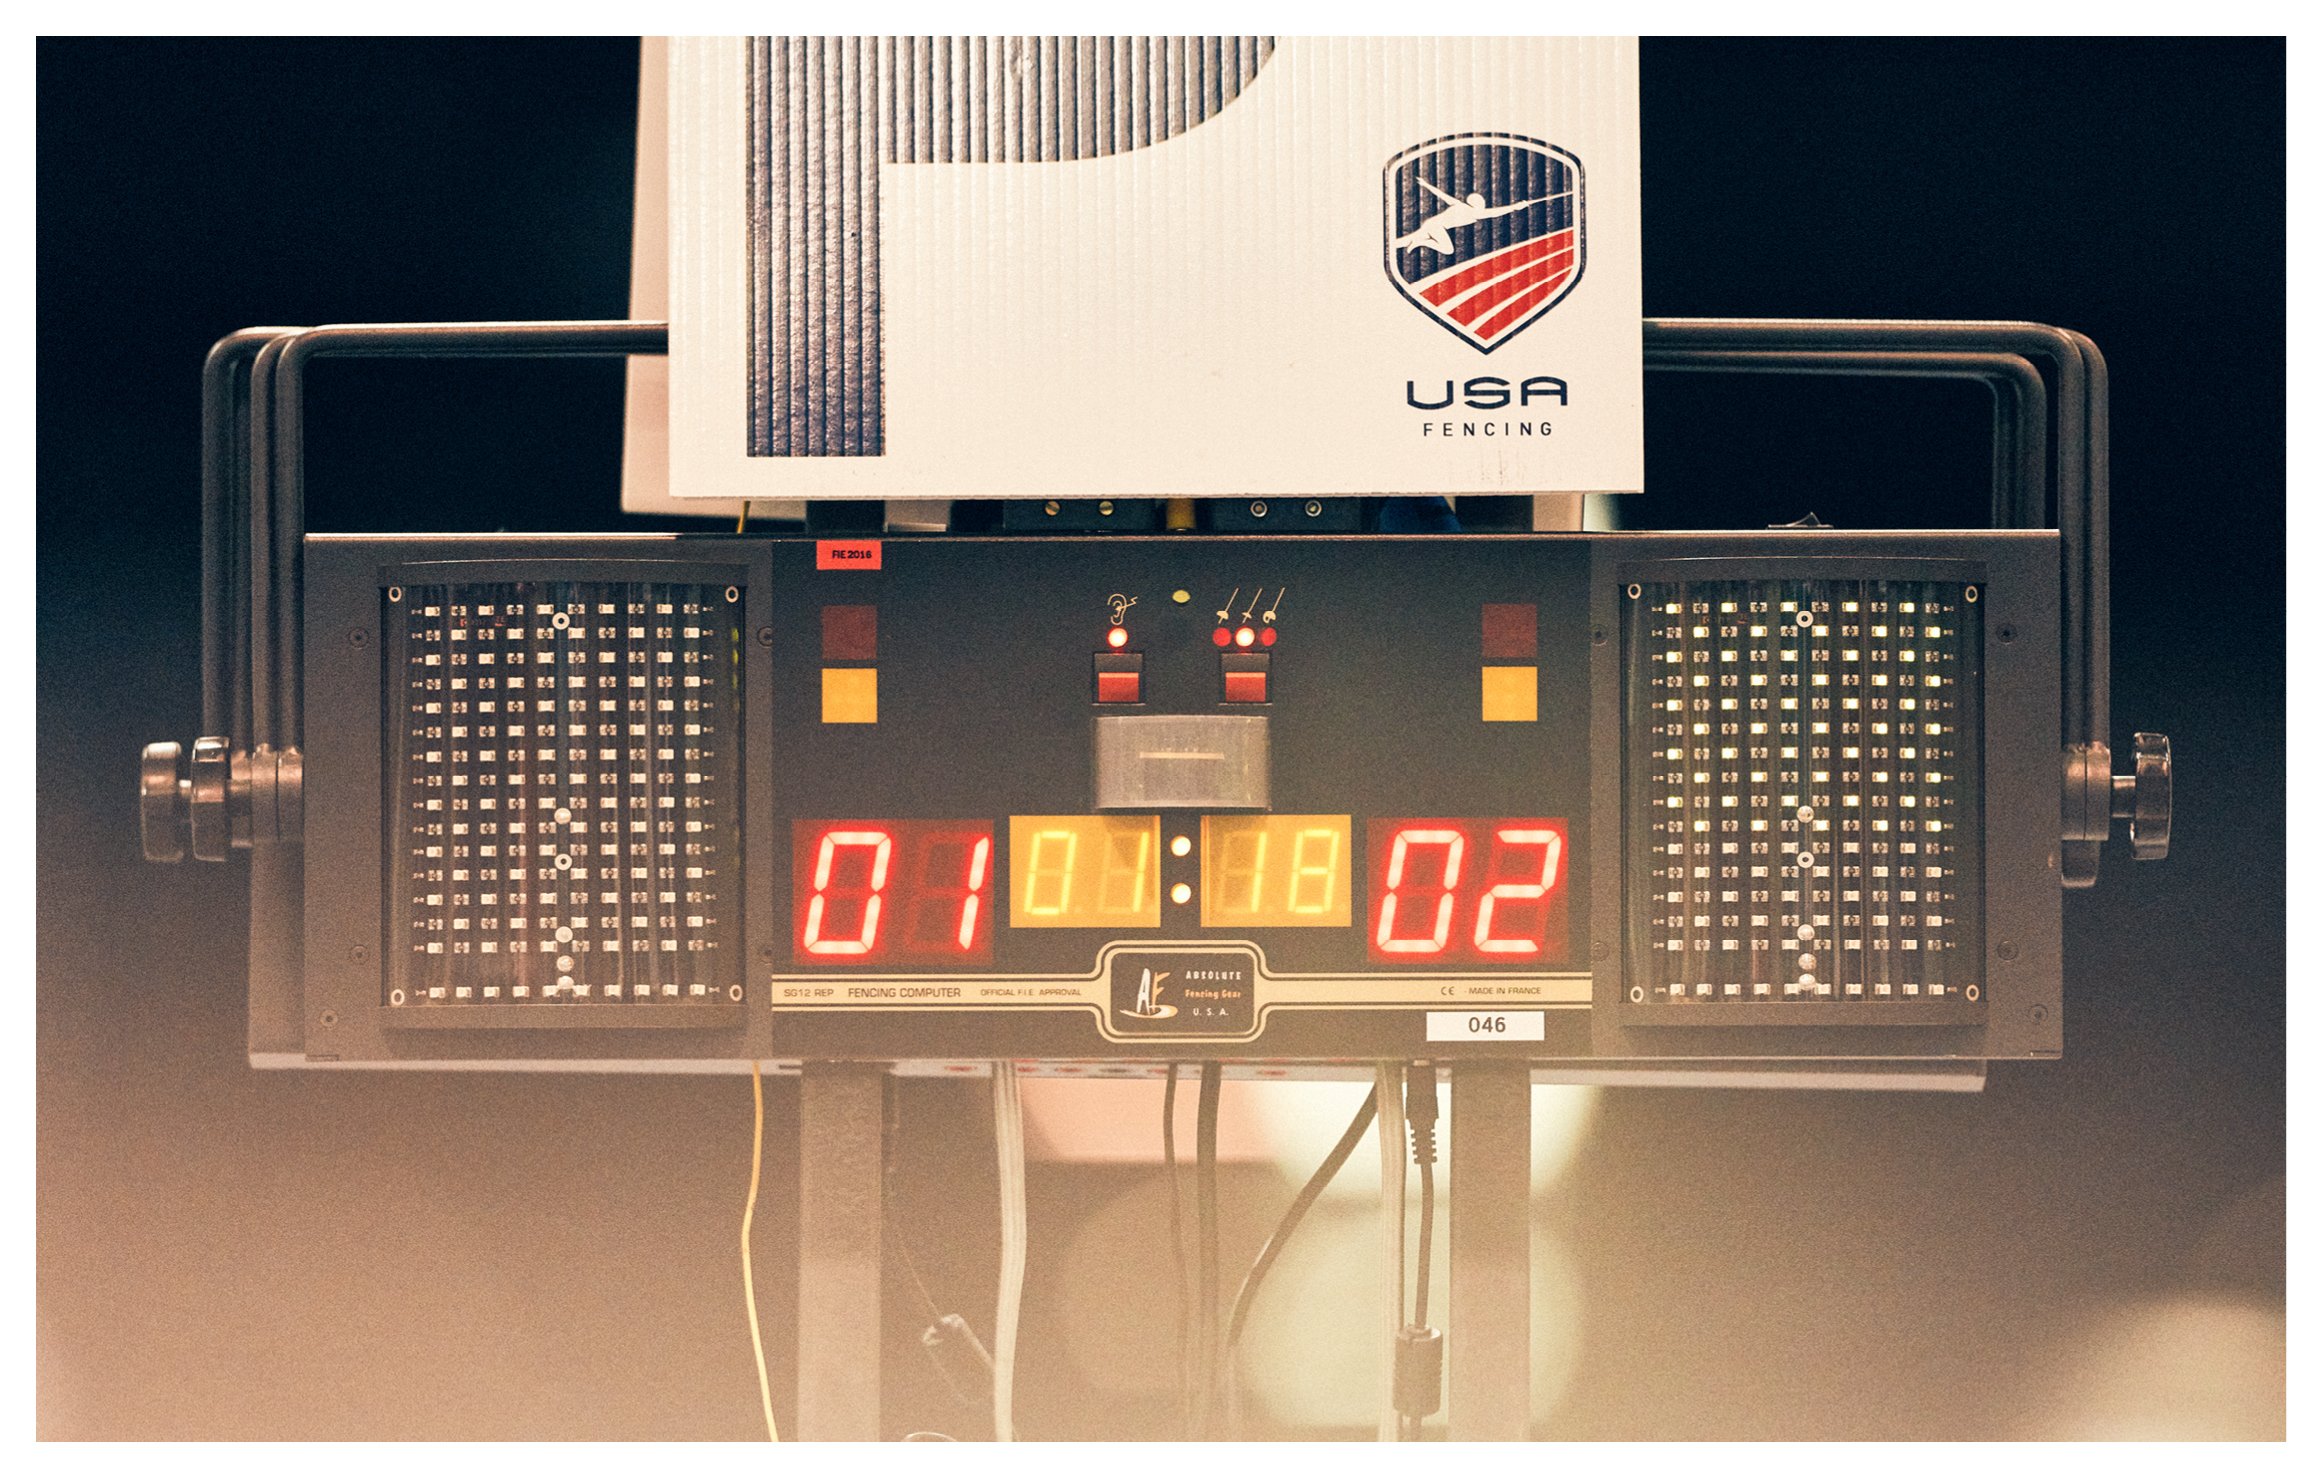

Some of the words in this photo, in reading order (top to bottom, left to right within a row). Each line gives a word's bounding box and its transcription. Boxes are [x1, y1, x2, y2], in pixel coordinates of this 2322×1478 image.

[1406, 376, 1568, 410] USA
[1423, 422, 1552, 437] FENCING
[804, 832, 989, 954] 01
[1377, 830, 1561, 952] 02
[1185, 970, 1242, 980] ABSOLUTE
[784, 988, 811, 997] SG12
[814, 988, 834, 997] REP
[848, 987, 896, 998] FENCING
[900, 987, 961, 998] COMPUTER
[980, 988, 1015, 996] OFFICIAL
[1039, 988, 1081, 996] APPROVAL
[1185, 989, 1219, 1000] Fencing
[1222, 989, 1241, 998] Gear
[1468, 987, 1494, 995] MADE
[1496, 987, 1505, 995] IN
[1508, 987, 1541, 995] FRANCE
[1468, 1016, 1506, 1033] 046
